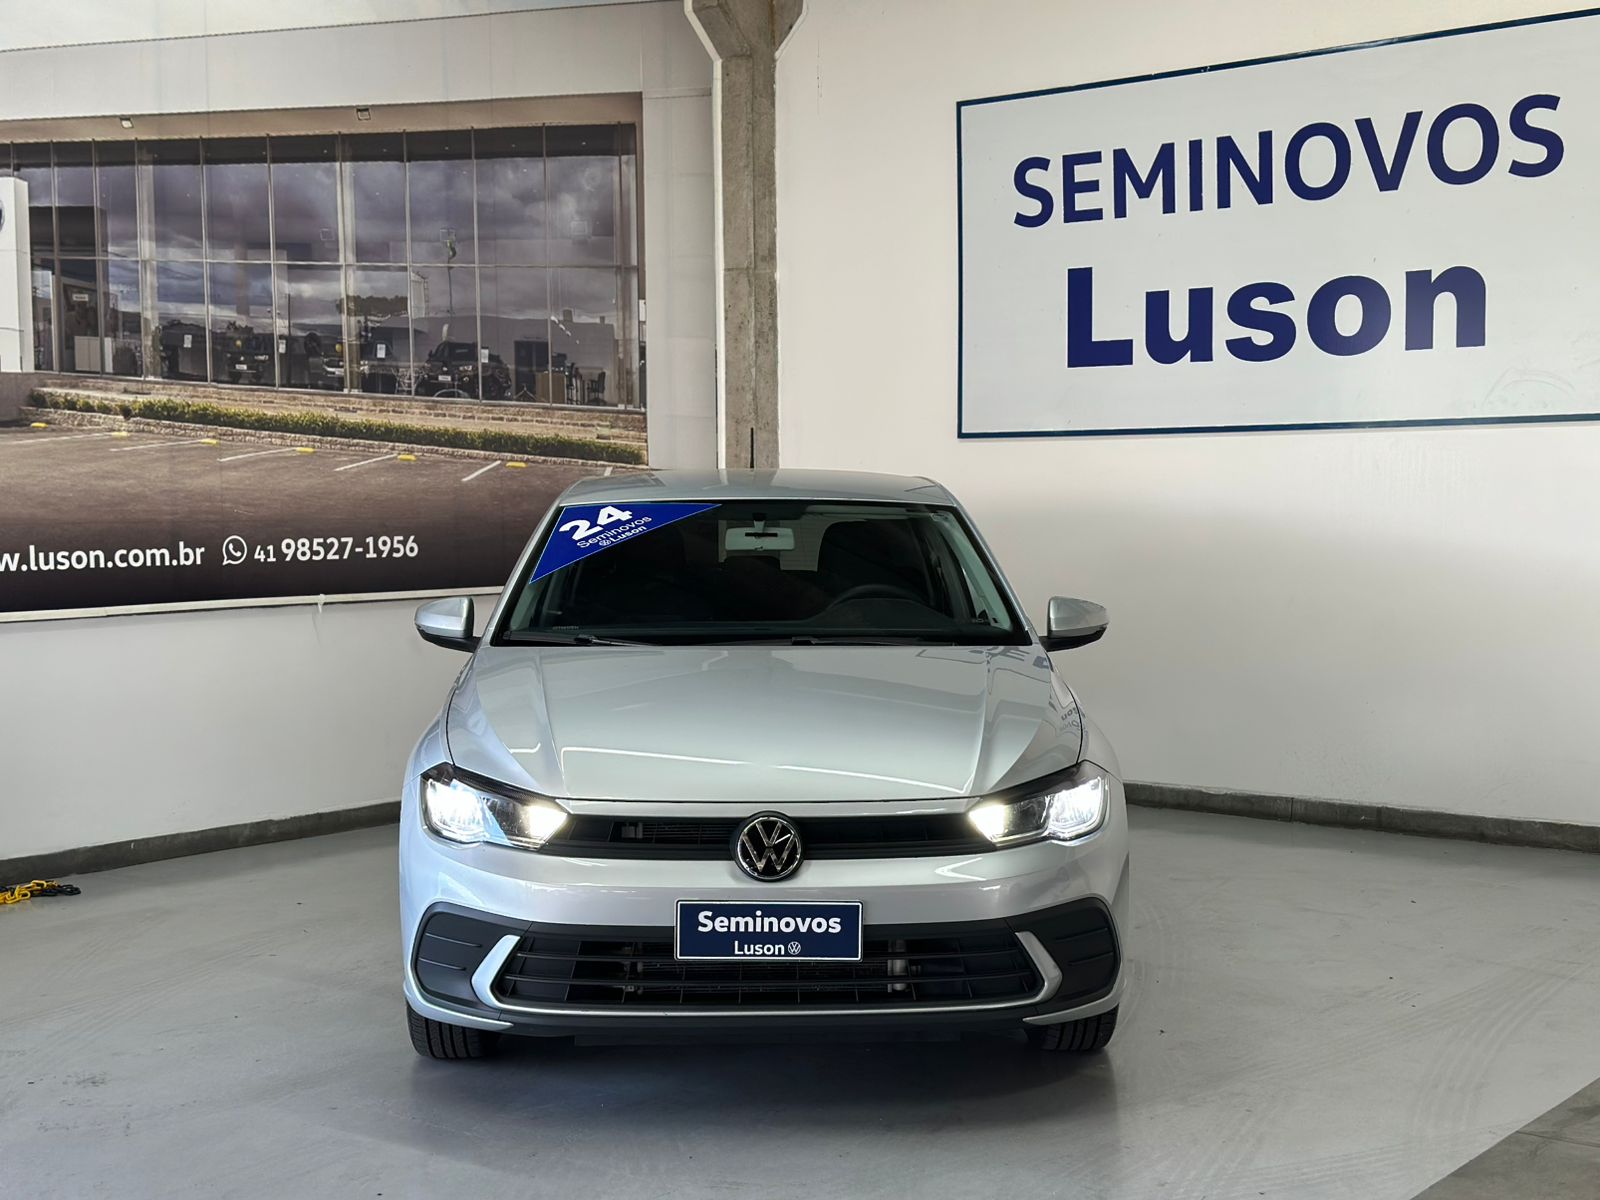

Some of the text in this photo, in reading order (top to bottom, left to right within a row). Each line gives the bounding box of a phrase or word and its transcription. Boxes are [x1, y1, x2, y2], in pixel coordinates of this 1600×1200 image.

[1013, 94, 1565, 228] SEMINOVOS
[1067, 266, 1487, 369] Luson
[559, 505, 633, 541] 24
[576, 517, 652, 548] Seminovos
[609, 526, 647, 542] Luson
[253, 535, 419, 563] 41 98527-1956
[697, 910, 842, 933] Seminovos
[734, 940, 785, 955] Luson
